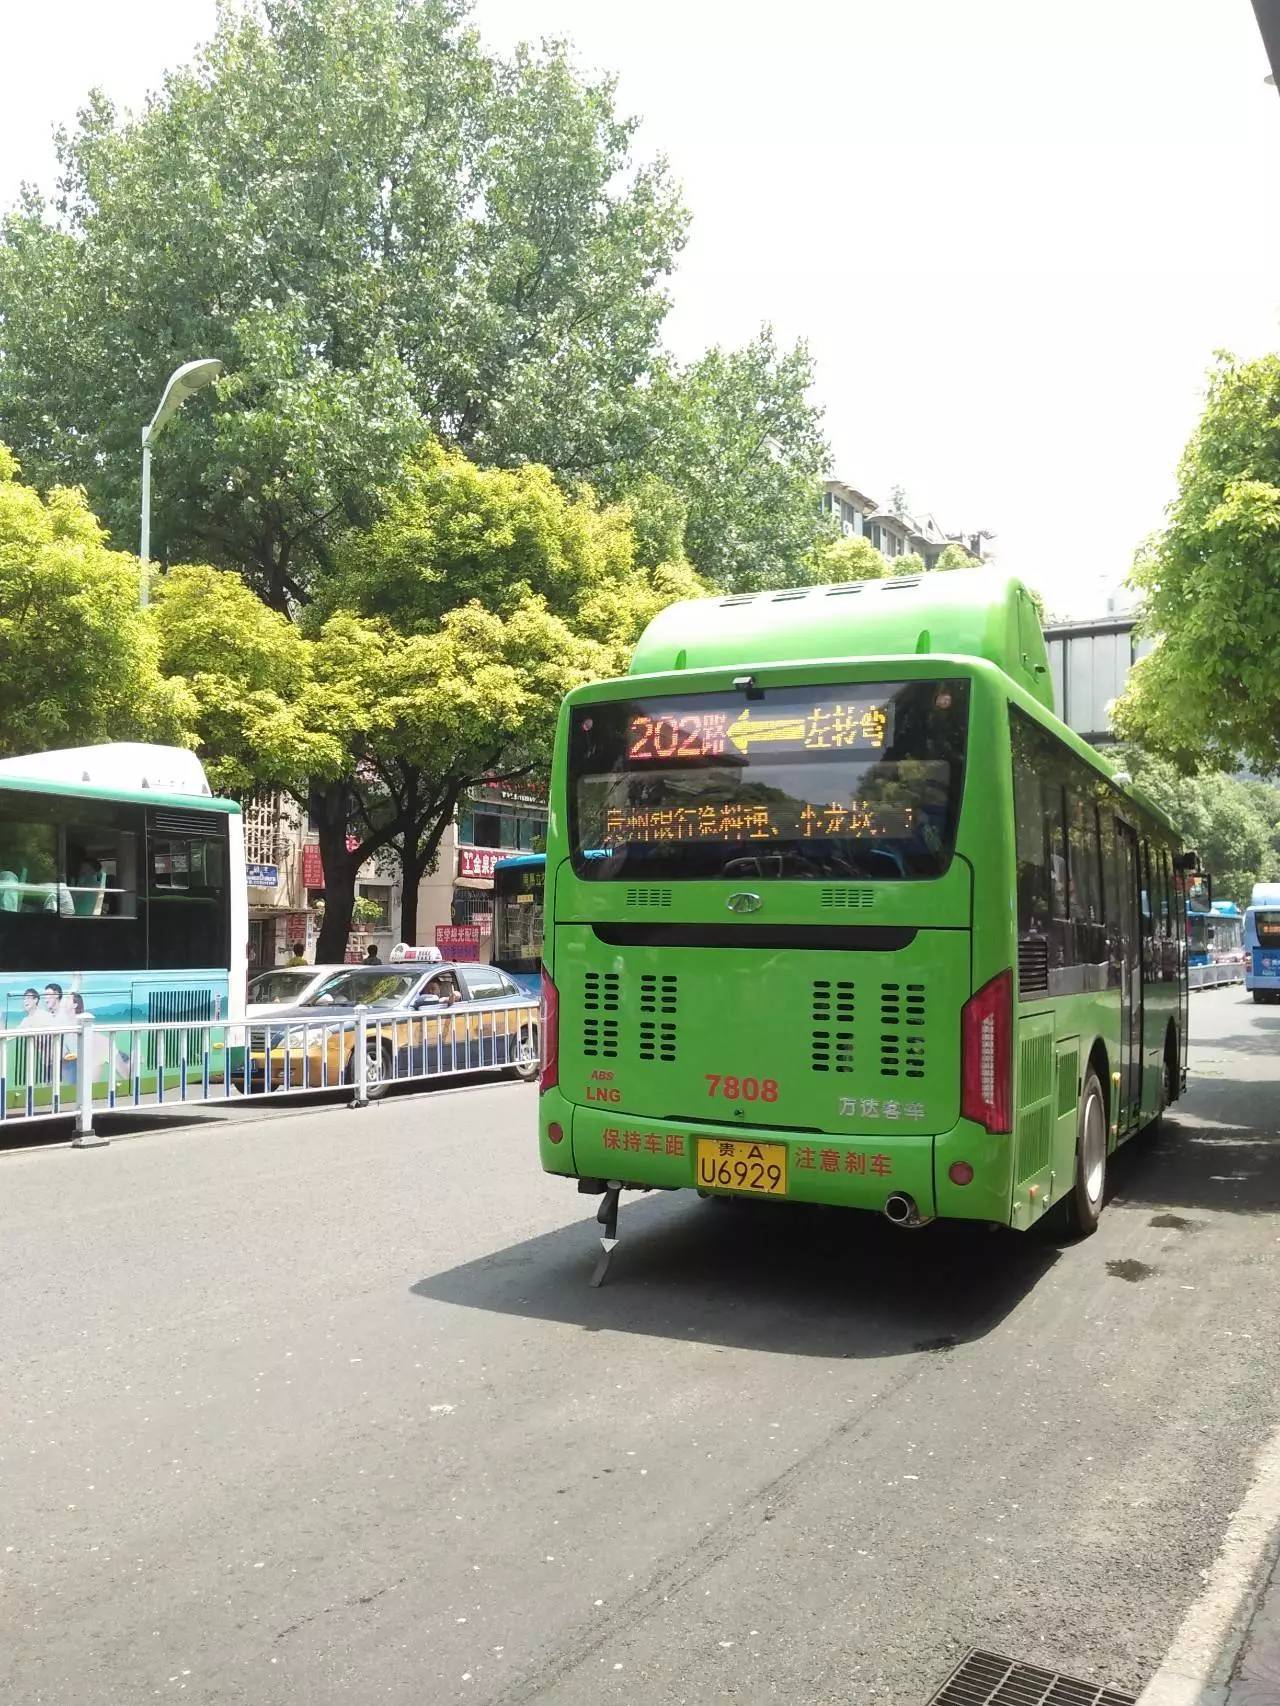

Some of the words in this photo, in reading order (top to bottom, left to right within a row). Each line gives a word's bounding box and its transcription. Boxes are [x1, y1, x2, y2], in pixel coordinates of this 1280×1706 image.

[590, 1070, 614, 1081] ABS
[704, 1074, 779, 1103] 7808
[586, 1086, 621, 1102] LNG
[839, 1097, 926, 1121] 万达客车
[602, 1128, 686, 1157] 保持车距
[701, 1159, 782, 1190] U6929
[794, 1147, 893, 1176] 注意刹车
